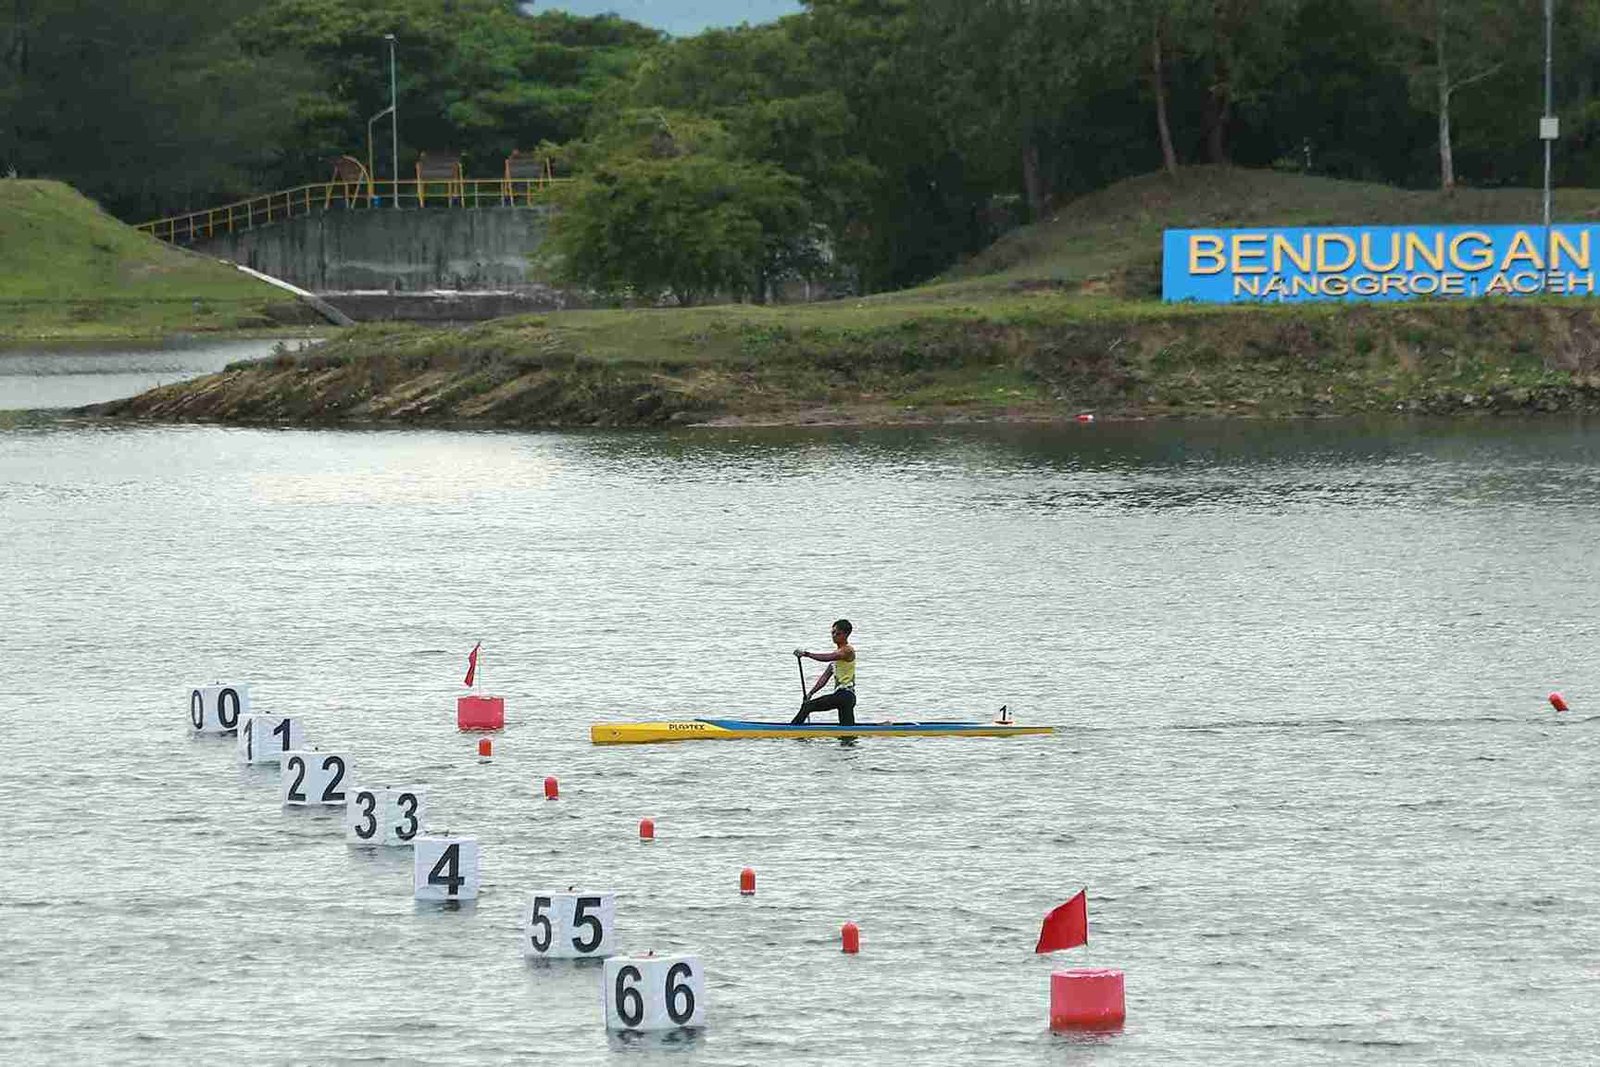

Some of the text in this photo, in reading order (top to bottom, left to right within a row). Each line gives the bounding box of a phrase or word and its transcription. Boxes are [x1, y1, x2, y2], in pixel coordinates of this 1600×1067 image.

[1188, 230, 1590, 275] BENDUNGAN
[1233, 272, 1595, 297] NANGGROE ACEH
[191, 690, 203, 729] 0
[218, 688, 240, 728] 0
[1000, 705, 1007, 721] 1
[243, 718, 252, 760] 1
[273, 718, 291, 751] 1
[287, 756, 306, 801] 2
[321, 756, 346, 801] 2
[355, 791, 377, 839] 3
[395, 793, 418, 840] 3
[428, 844, 465, 895] 4
[531, 897, 552, 952] 5
[572, 897, 603, 953] 5
[615, 965, 644, 1027] 6
[665, 962, 695, 1025] 6
